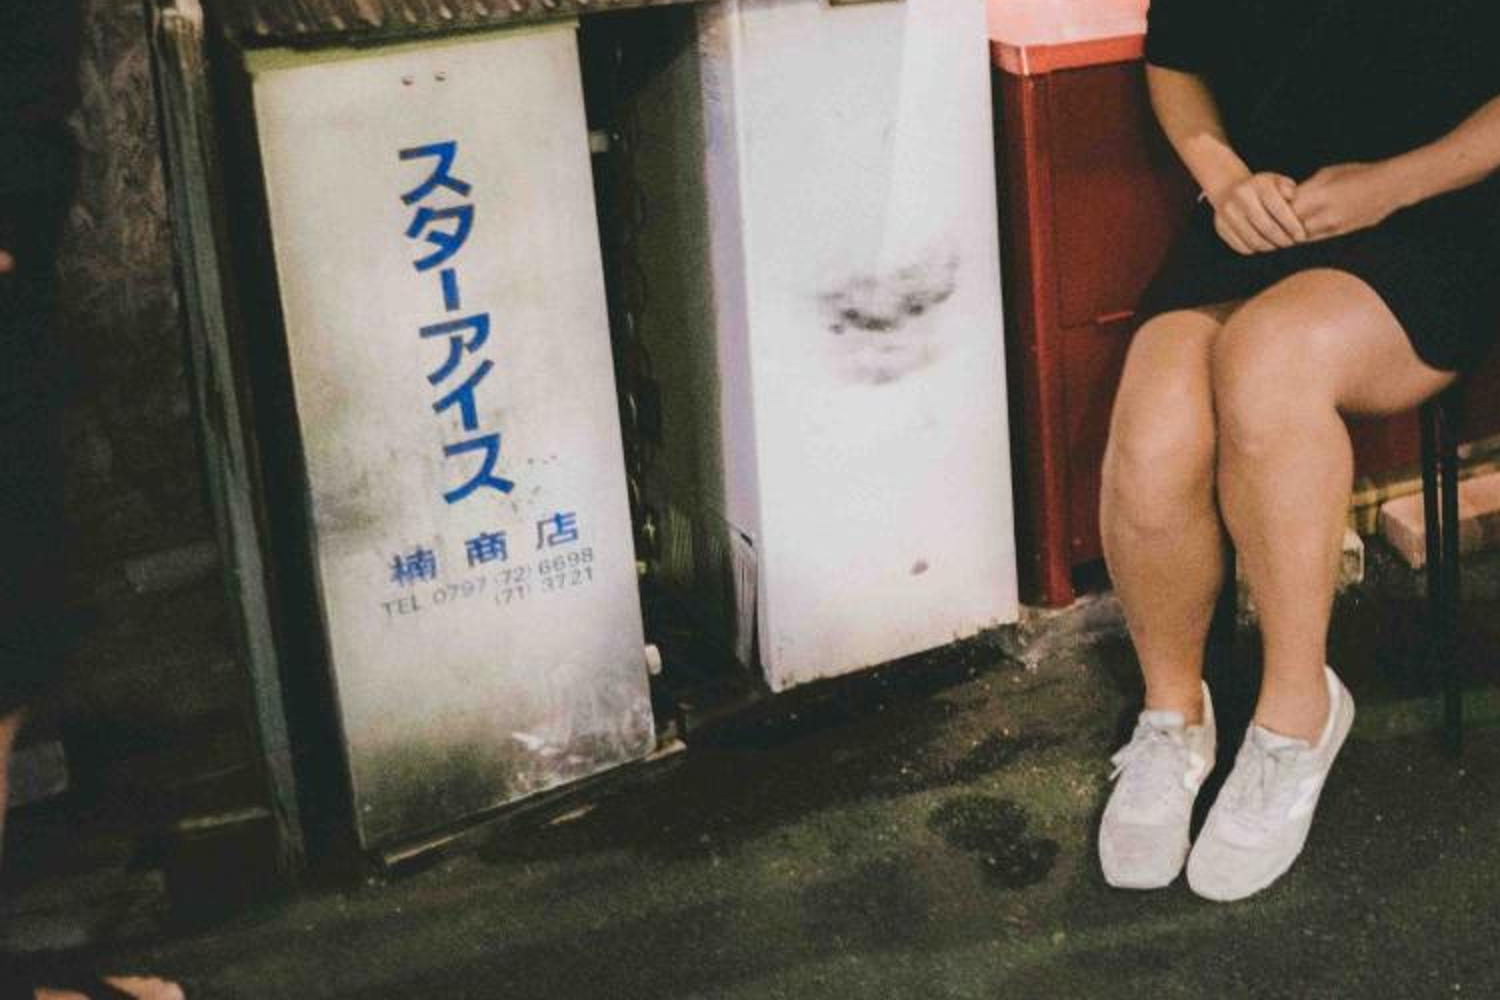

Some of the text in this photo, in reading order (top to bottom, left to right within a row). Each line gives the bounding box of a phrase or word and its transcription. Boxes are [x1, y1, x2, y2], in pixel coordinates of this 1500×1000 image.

[398, 140, 515, 504] スターアイス
[381, 595, 421, 617] TEL
[432, 577, 487, 605] 0797
